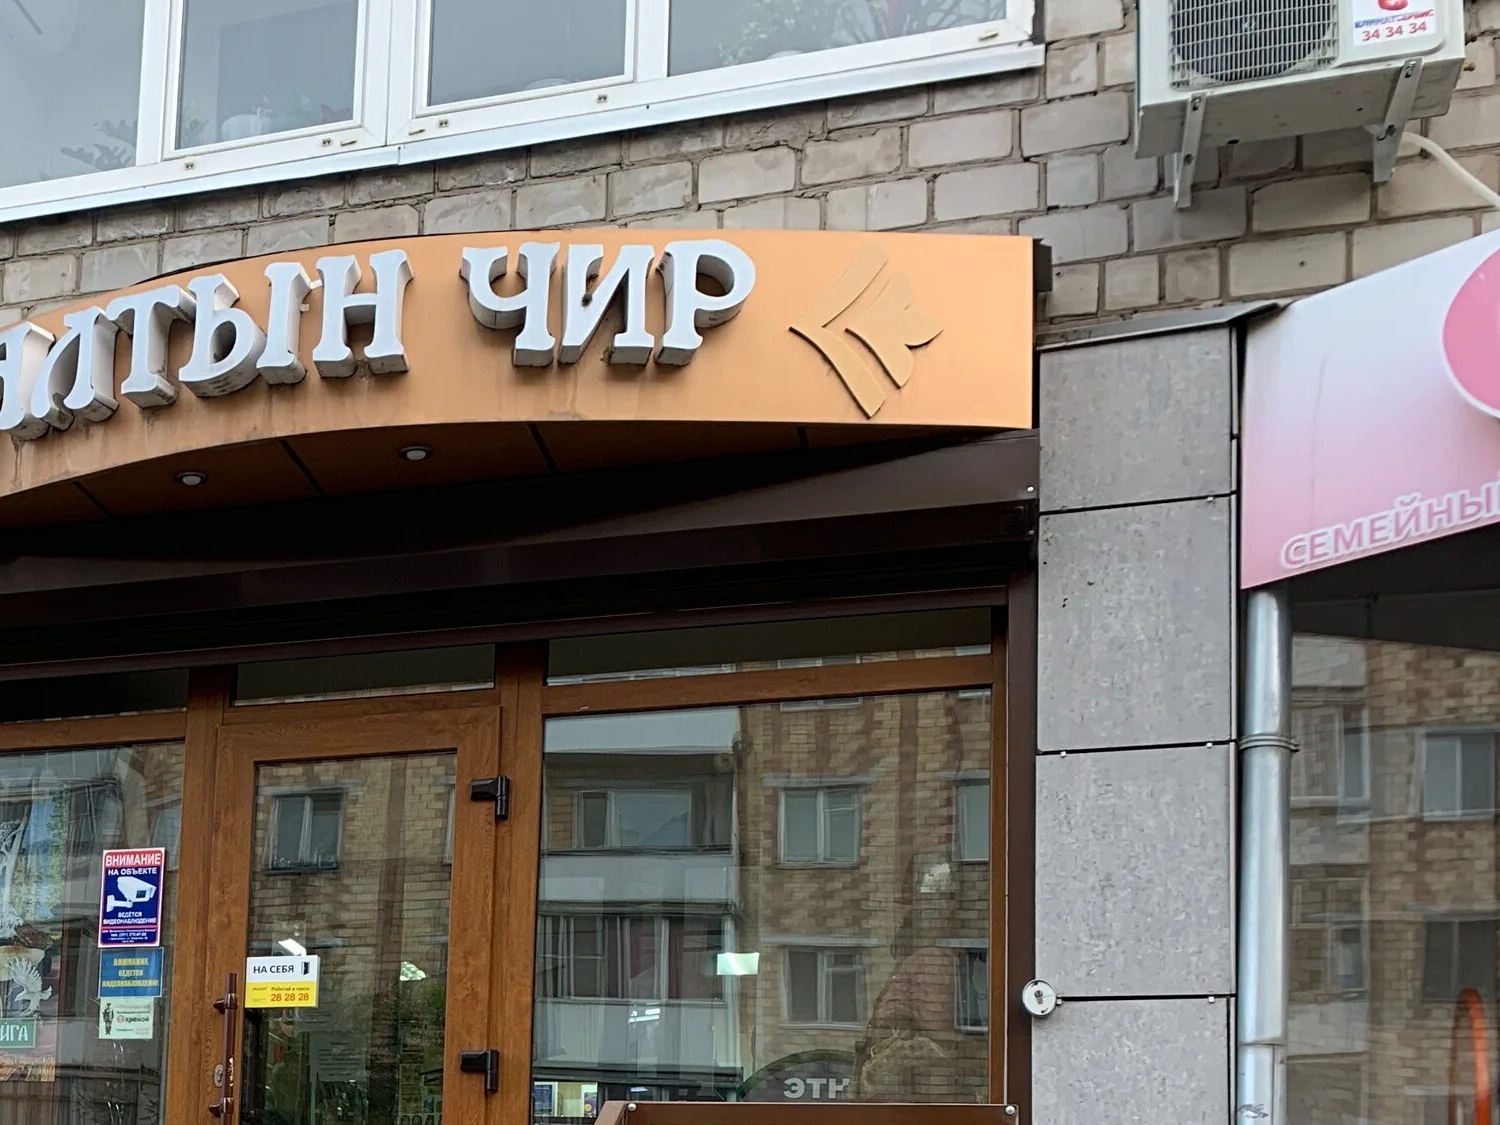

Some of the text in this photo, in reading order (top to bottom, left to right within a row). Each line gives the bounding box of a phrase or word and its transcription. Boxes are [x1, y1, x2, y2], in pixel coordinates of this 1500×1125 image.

[1362, 21, 1427, 41] 34 34 34
[461, 238, 757, 368] ЧИР
[1280, 474, 1500, 570] СЕМЕЙНЫ
[105, 853, 162, 867] ВНИМАНИЕ
[107, 867, 157, 876] НА ОБЪЕКТЕ
[253, 964, 295, 974] НА СЕБЯ
[270, 993, 282, 1002] 28
[284, 993, 296, 1002] 28
[298, 992, 309, 1001] 28
